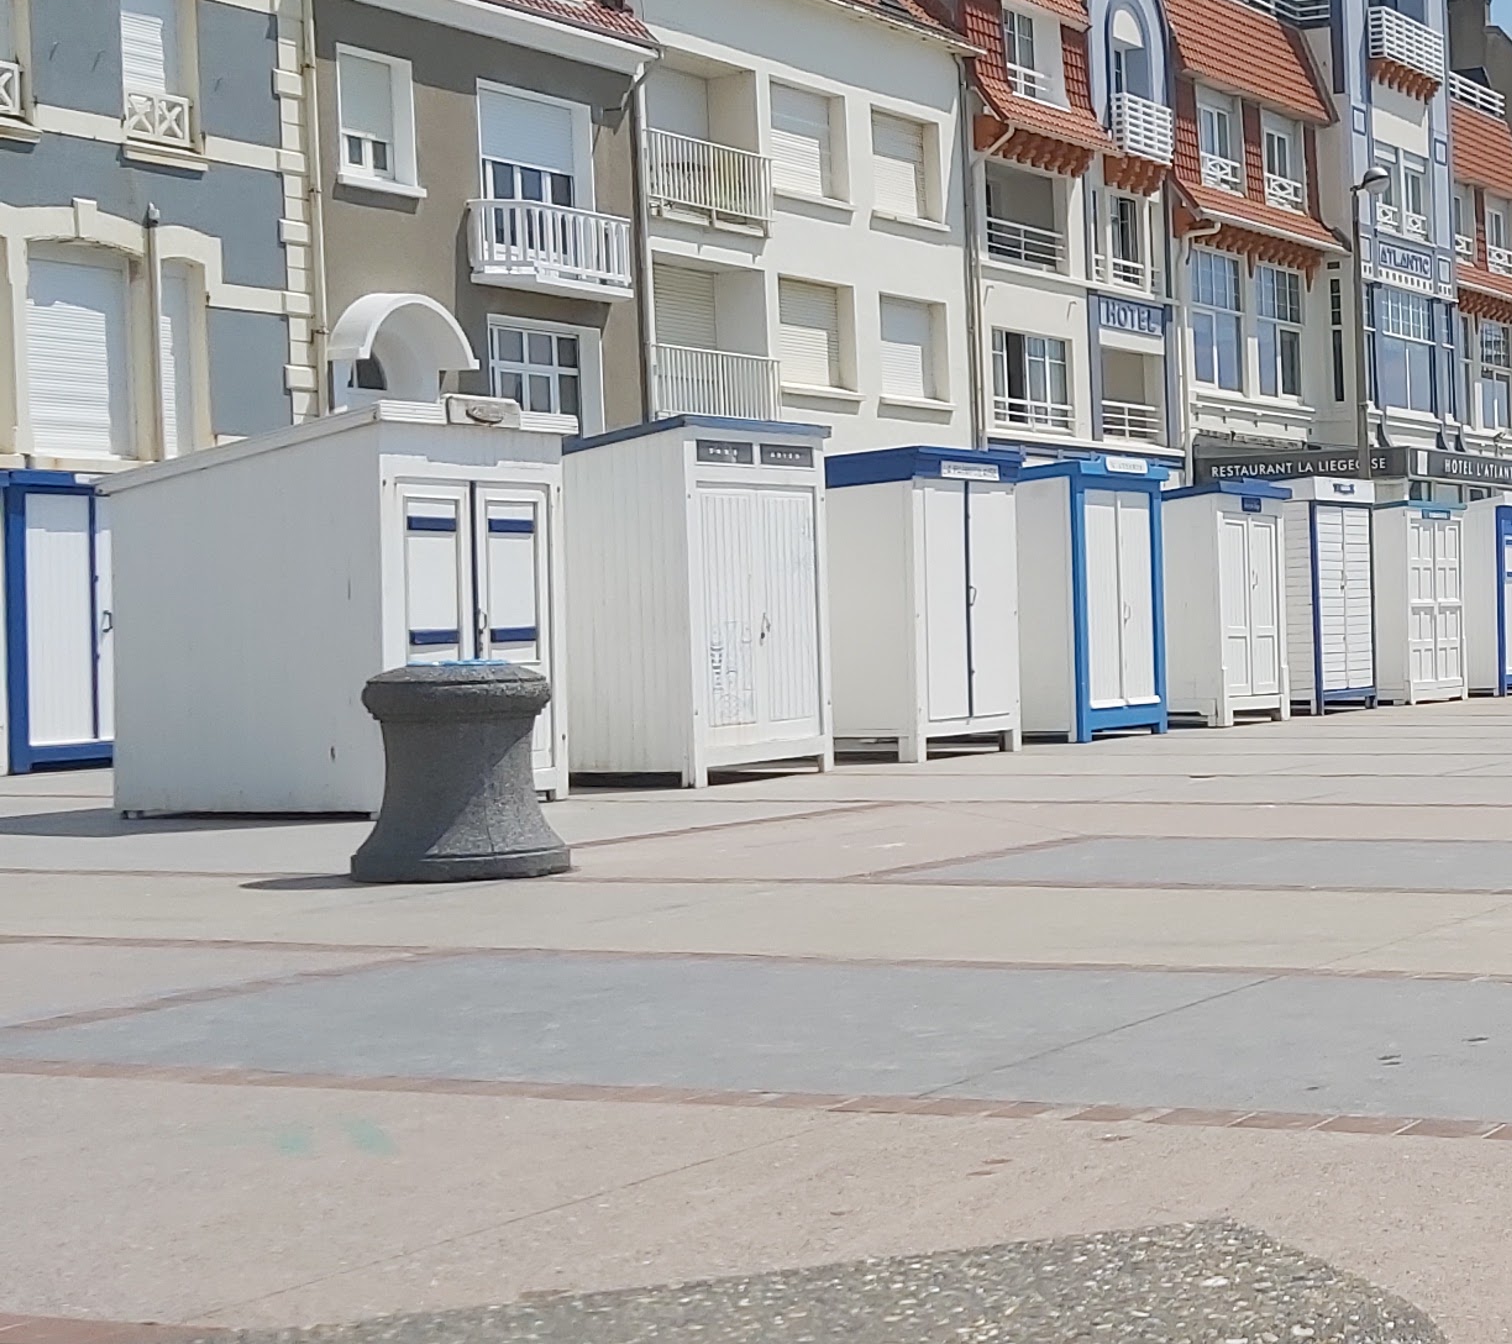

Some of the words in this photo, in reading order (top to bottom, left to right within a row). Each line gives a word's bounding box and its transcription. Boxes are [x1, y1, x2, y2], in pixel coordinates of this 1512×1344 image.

[1381, 247, 1430, 275] ATLANTIC
[1106, 300, 1157, 333] HOTEL
[1211, 462, 1293, 477] RESTAURANT
[1298, 461, 1314, 473] LA
[1318, 457, 1386, 472] LIEGESE
[1444, 459, 1473, 475] HOTEL
